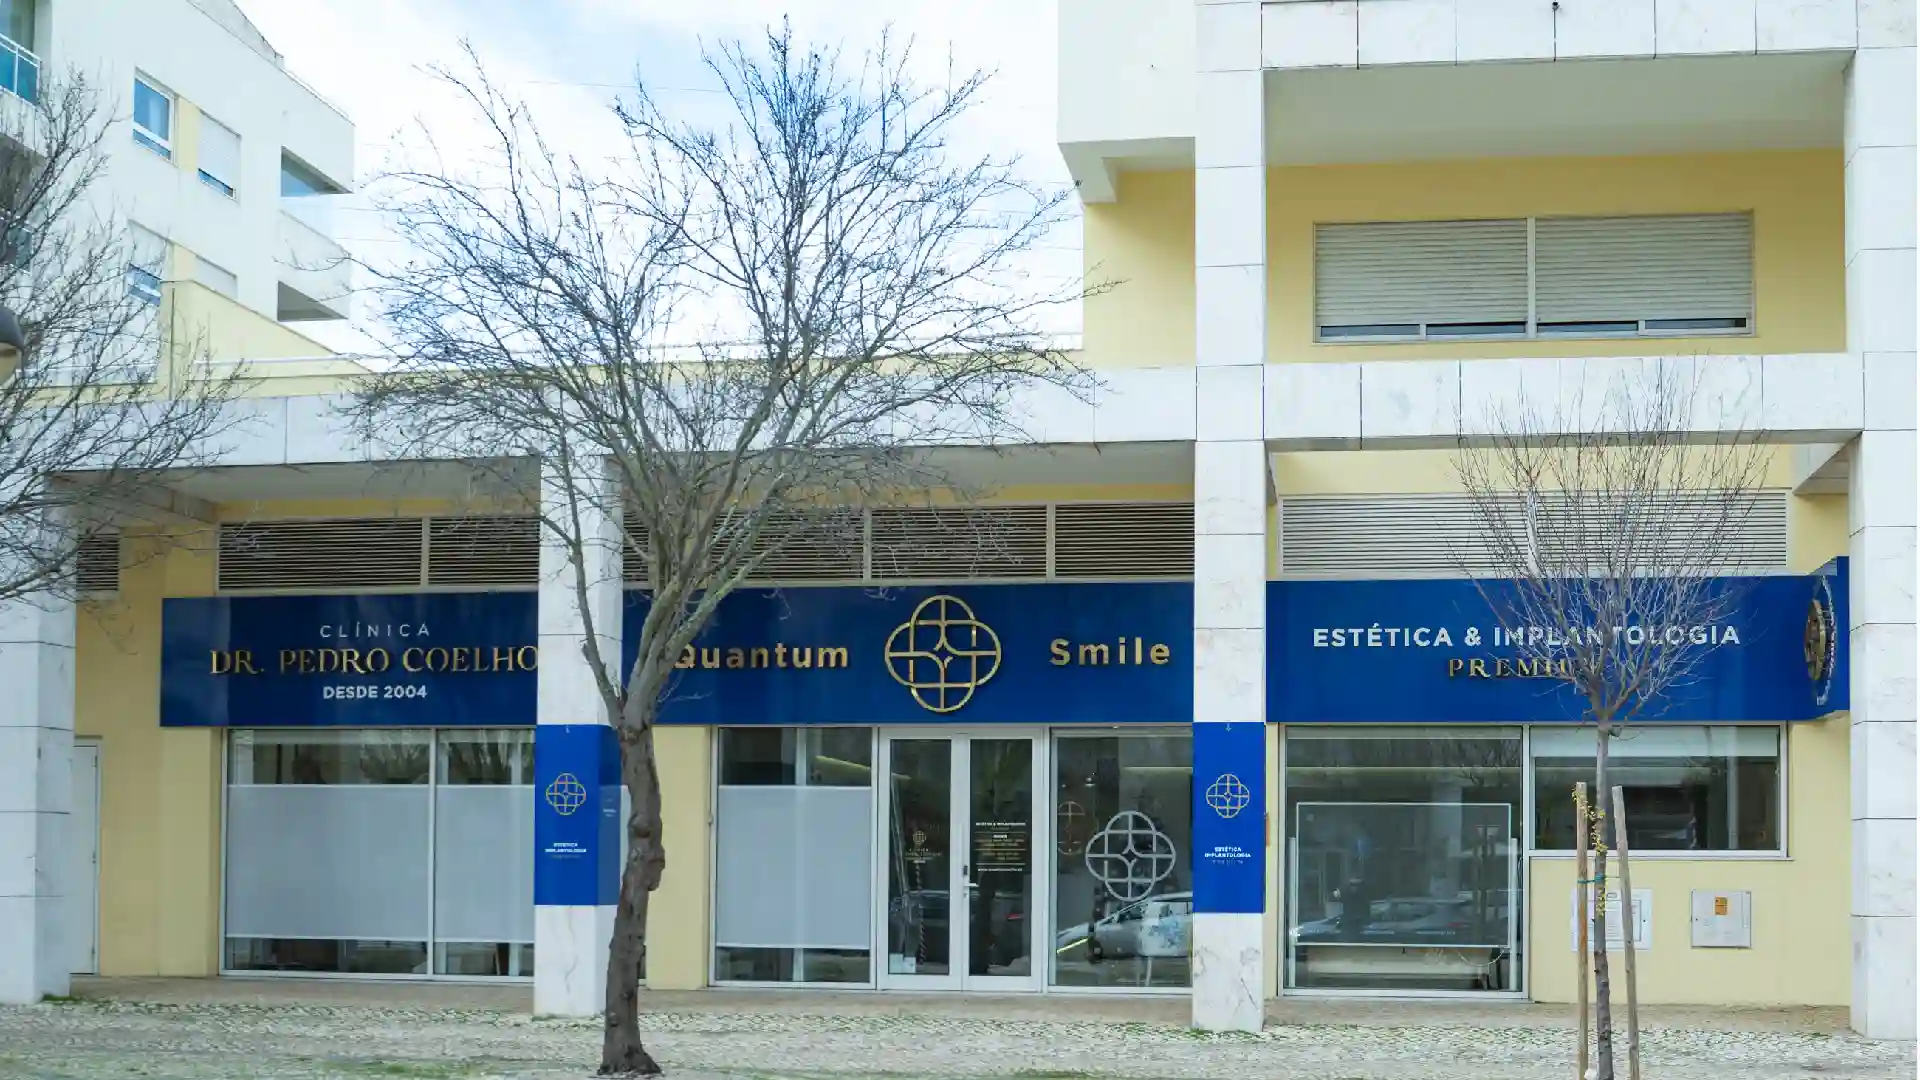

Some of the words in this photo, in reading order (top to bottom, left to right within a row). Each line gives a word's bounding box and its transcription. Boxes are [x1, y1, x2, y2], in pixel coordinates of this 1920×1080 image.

[320, 622, 430, 638] CLÍNICA
[1313, 622, 1454, 647] ESTÉTICA
[1464, 626, 1482, 647] &
[210, 649, 265, 674] DR.
[279, 648, 390, 674] PEDRO
[402, 645, 539, 673] COELHO
[1049, 636, 1171, 666] Smile
[323, 685, 378, 699] DESDE
[383, 684, 428, 699] 2004
